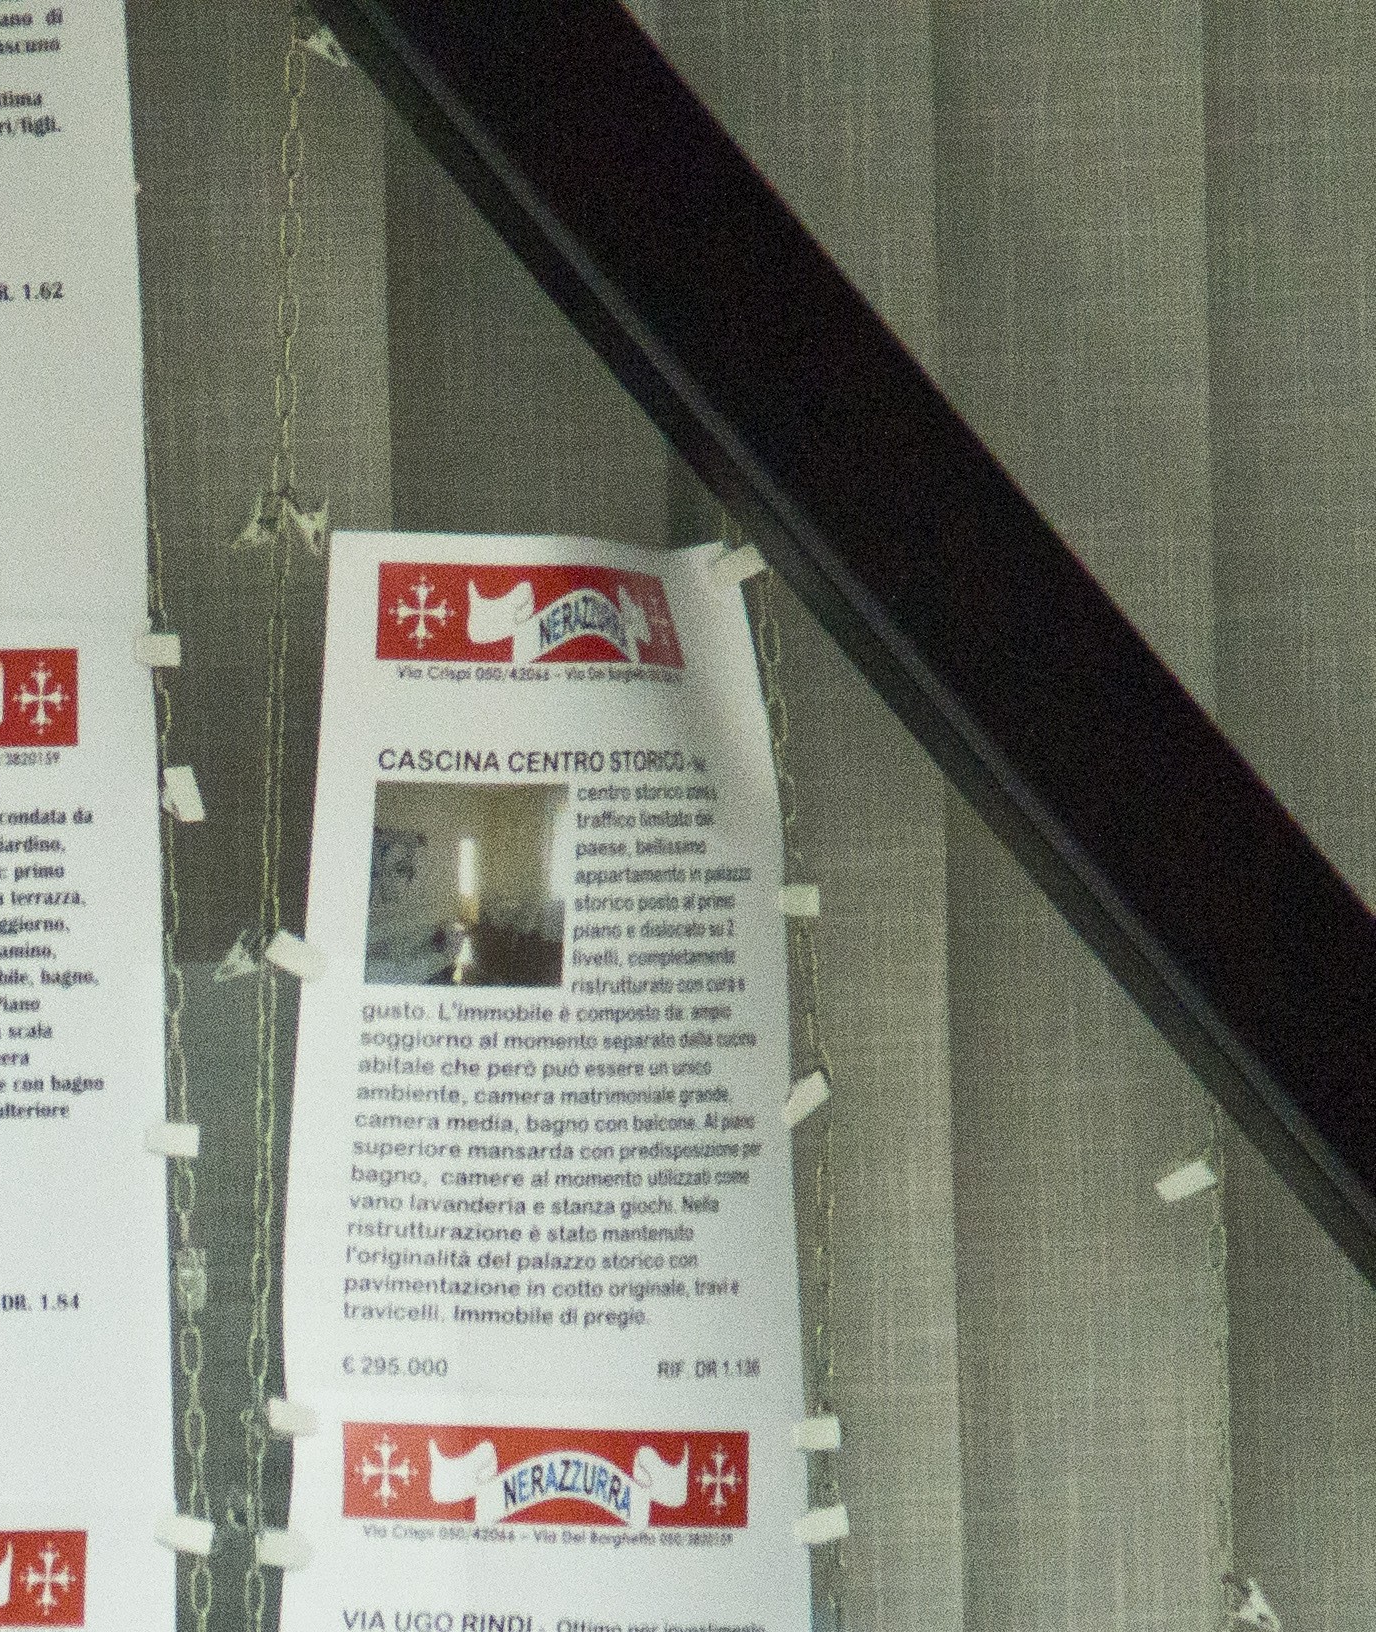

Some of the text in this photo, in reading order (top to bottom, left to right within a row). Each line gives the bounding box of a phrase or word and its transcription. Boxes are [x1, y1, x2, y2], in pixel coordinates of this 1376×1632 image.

[377, 748, 501, 773] CASCINA
[507, 749, 605, 774] CENTRO
[341, 1355, 449, 1378] € 295.000
[504, 1459, 631, 1514] NERAZZURRA
[342, 1610, 386, 1632] VIA
[395, 1612, 453, 1632] UGO
